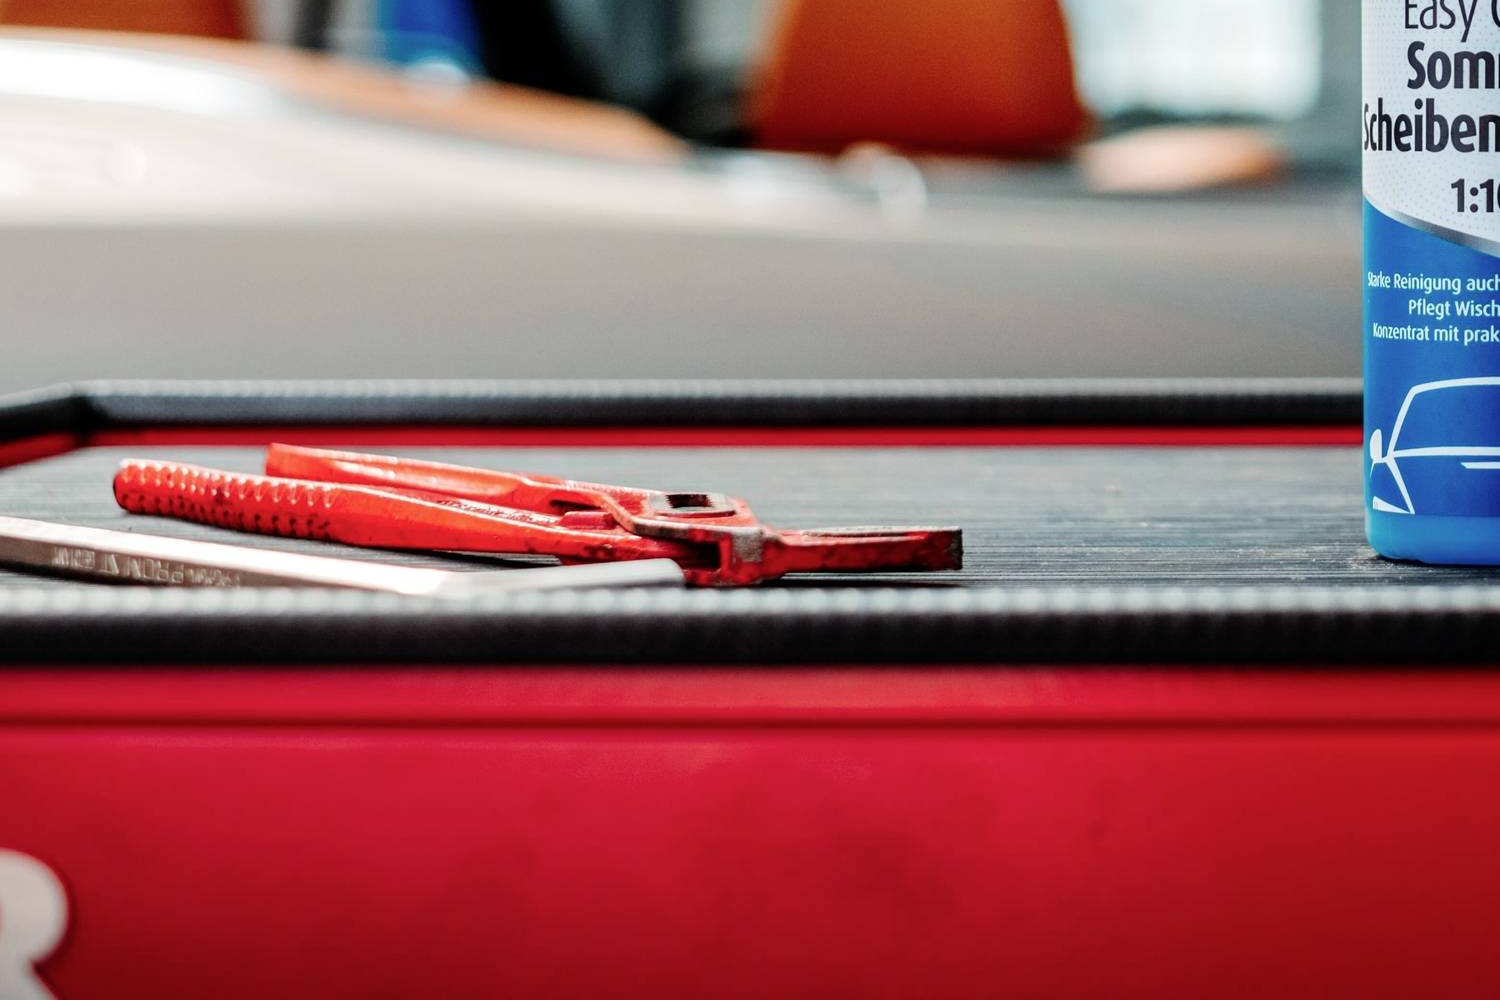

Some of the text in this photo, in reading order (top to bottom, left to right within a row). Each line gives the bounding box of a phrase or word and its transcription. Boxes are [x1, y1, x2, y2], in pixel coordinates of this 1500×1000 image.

[1368, 271, 1390, 288] Starke
[1394, 275, 1461, 294] Reinigung
[1409, 300, 1450, 320] Pflegt
[1373, 323, 1429, 341] Konzentrat
[1434, 325, 1458, 341] mit
